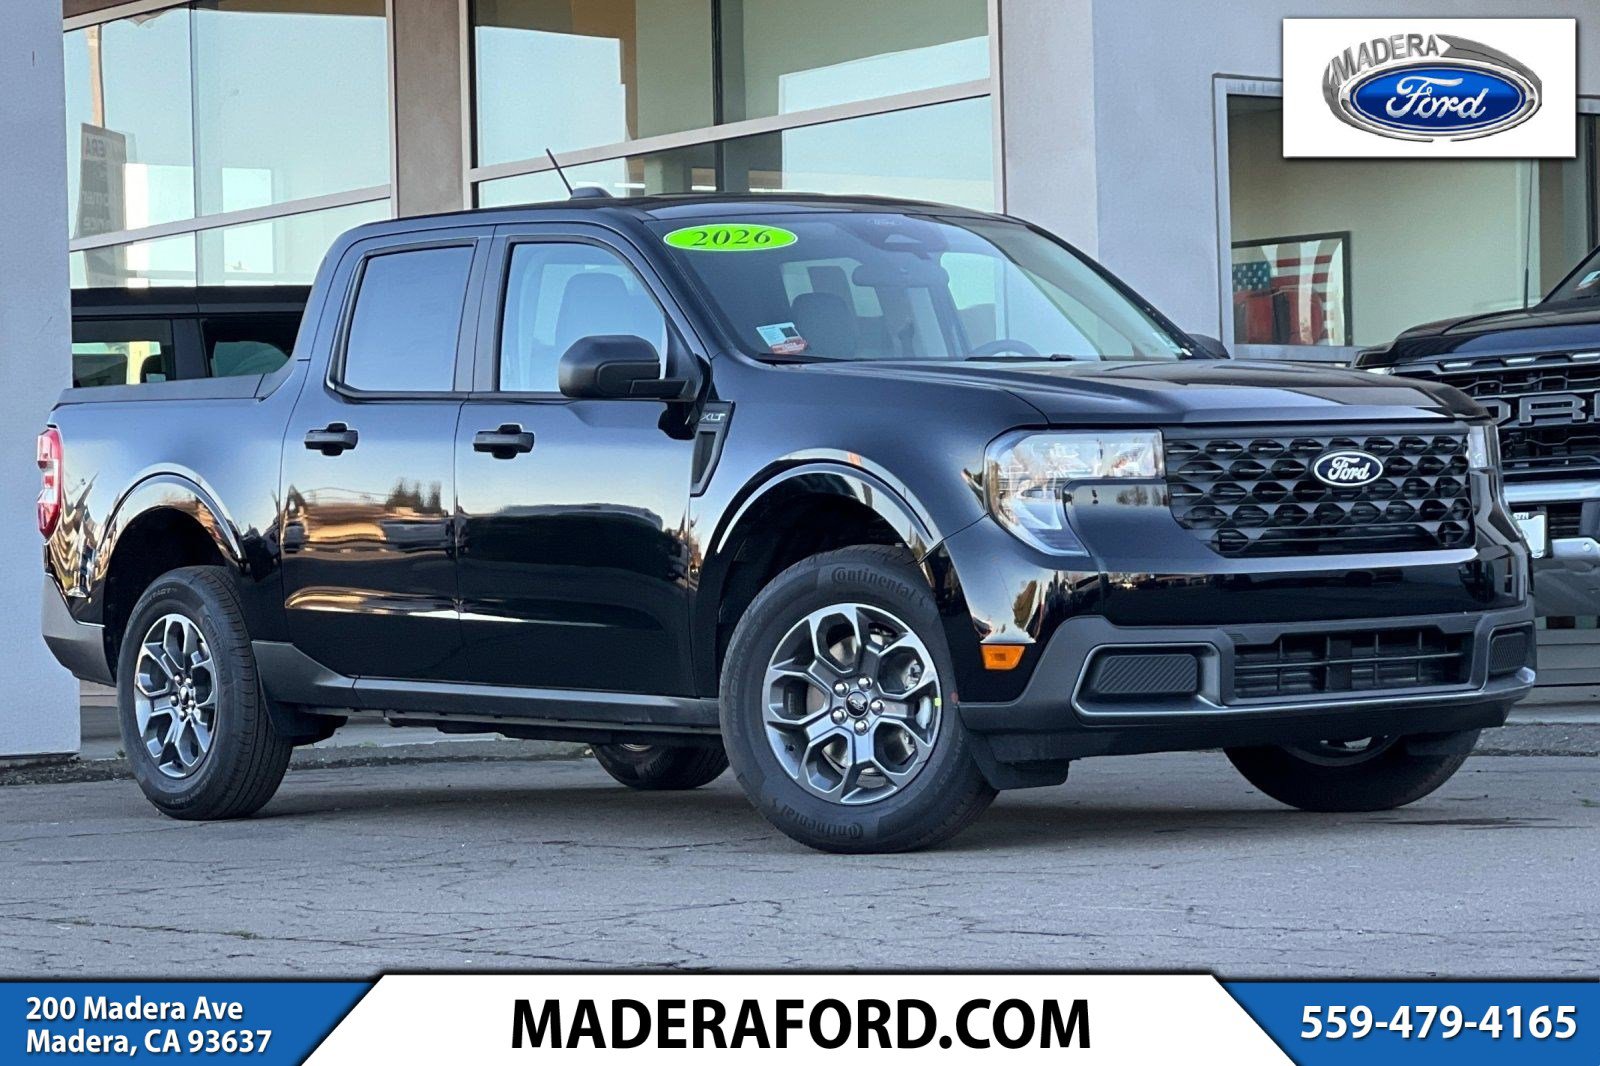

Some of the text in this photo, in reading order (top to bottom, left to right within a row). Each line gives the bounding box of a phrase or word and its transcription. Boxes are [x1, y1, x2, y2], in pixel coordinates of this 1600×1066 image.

[691, 229, 771, 246] 2026
[700, 413, 726, 421] XLT
[1327, 456, 1371, 480] Ford
[831, 566, 917, 600] Continental
